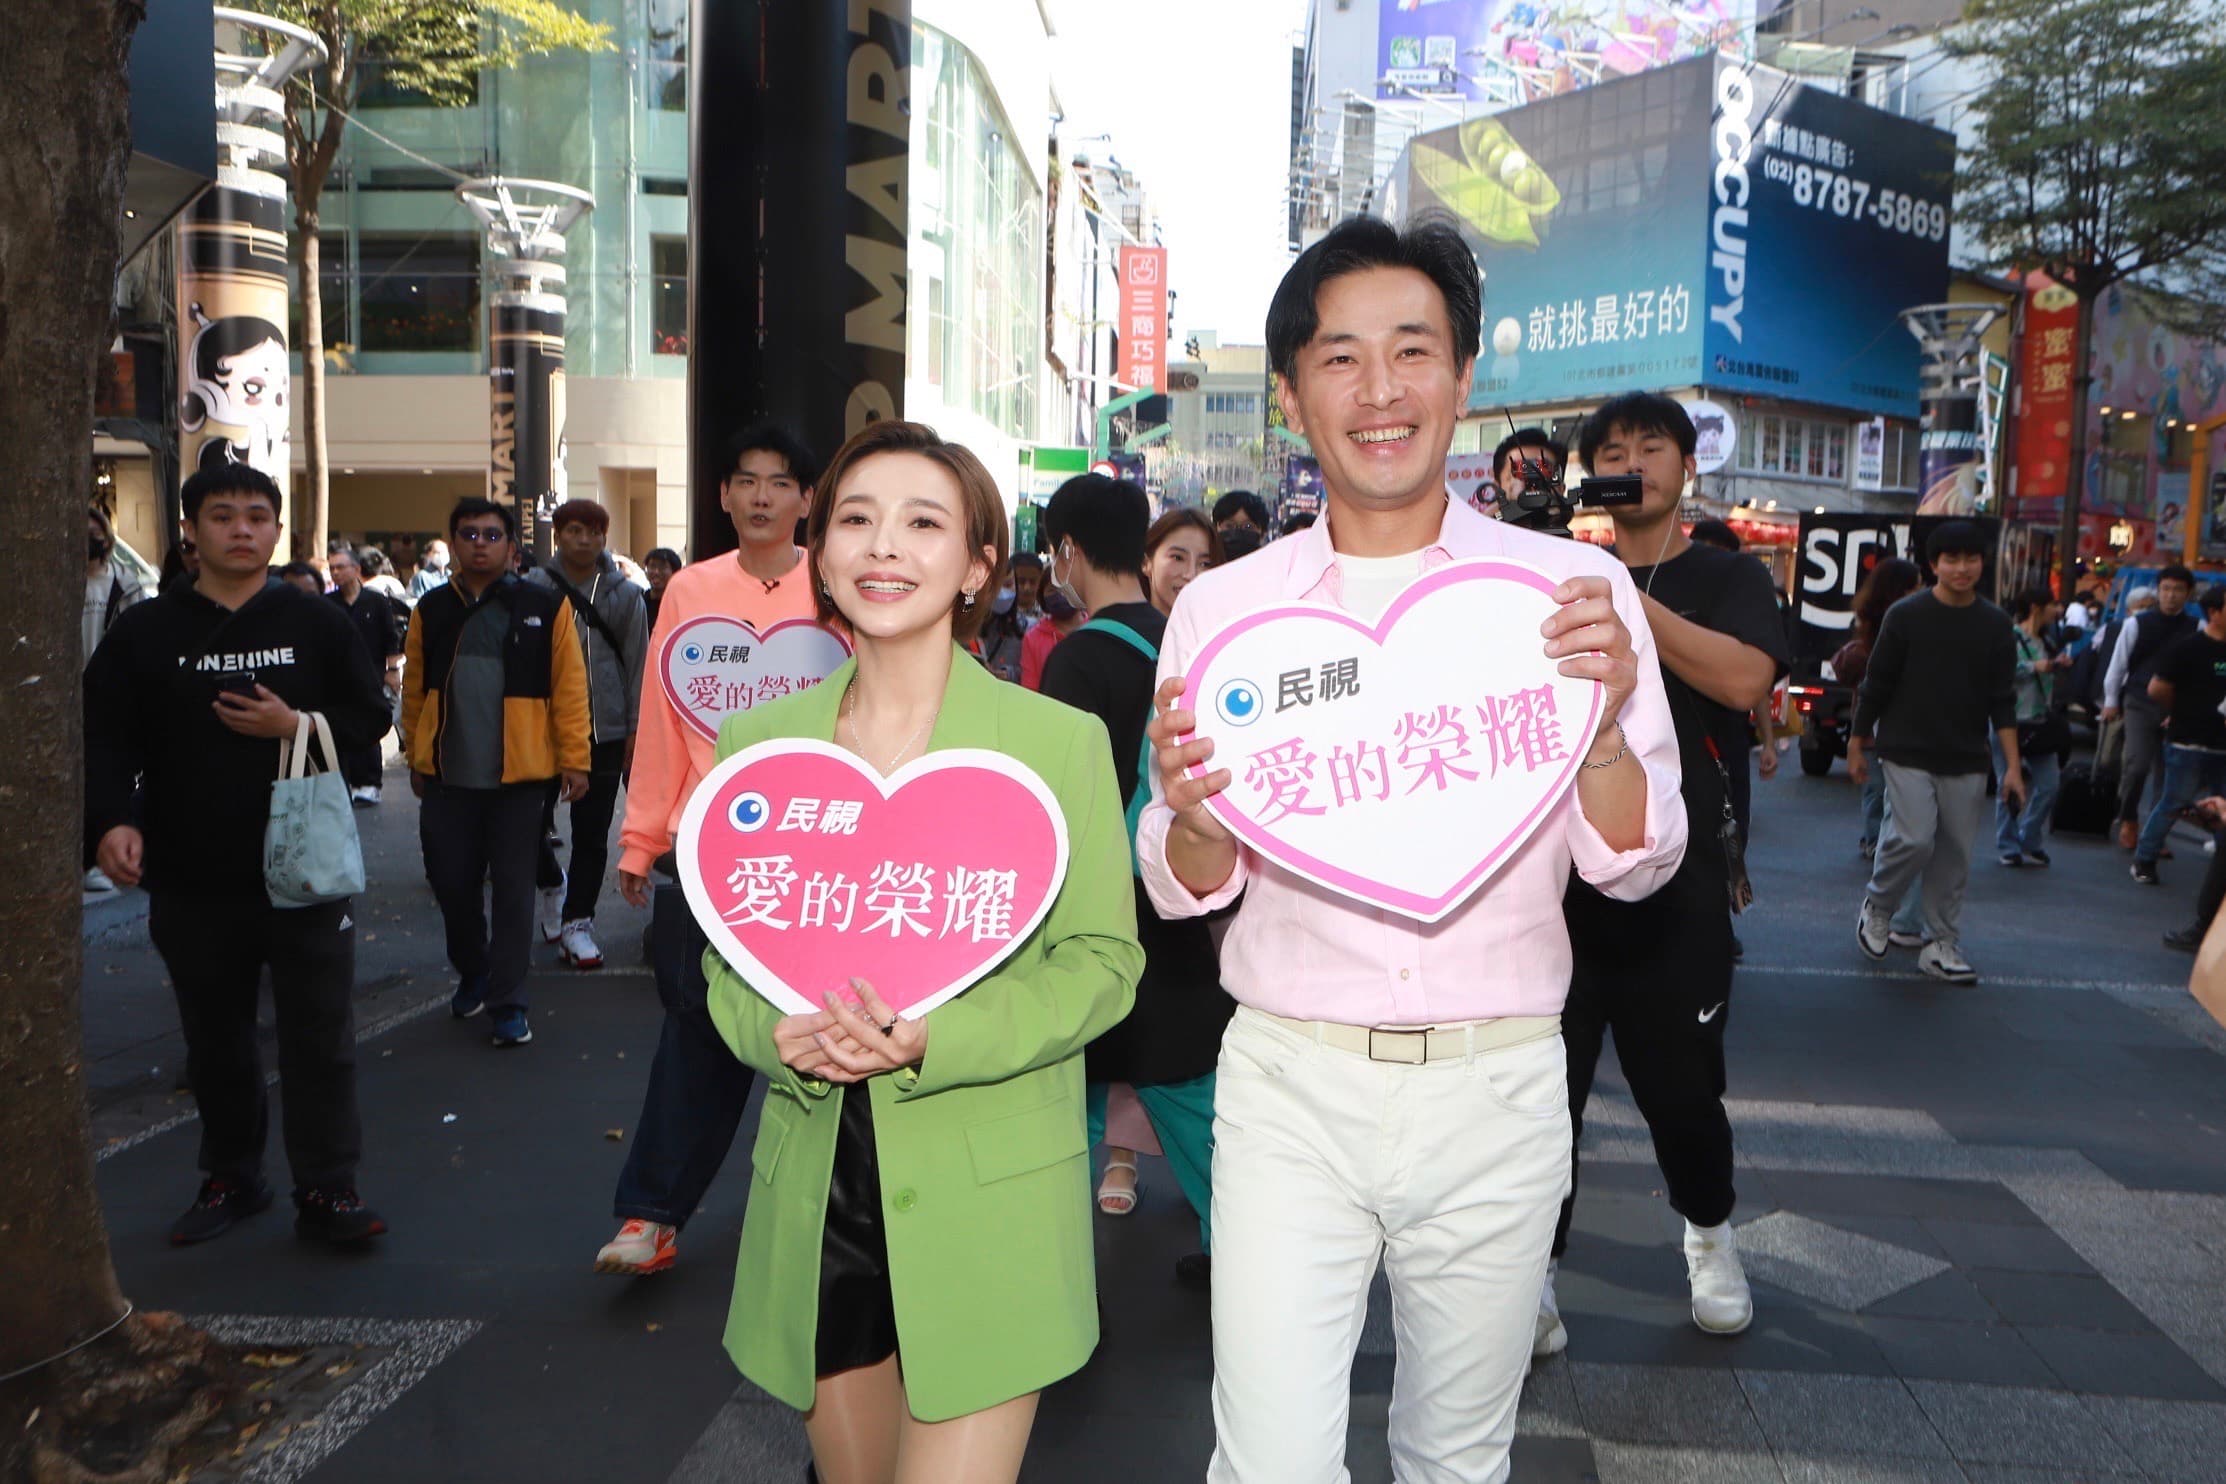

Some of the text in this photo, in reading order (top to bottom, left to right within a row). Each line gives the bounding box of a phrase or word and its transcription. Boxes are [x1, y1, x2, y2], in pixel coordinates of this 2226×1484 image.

[1711, 65, 1753, 345] OCCUPY
[1527, 283, 1690, 353] 就挑最好的
[707, 644, 750, 664] 民視
[1275, 657, 1360, 714] 民視
[686, 674, 824, 712] 愛的榮
[1243, 682, 1570, 828] 愛的榮耀
[776, 797, 864, 835] 民視
[722, 854, 1018, 943] 愛的榮耀
